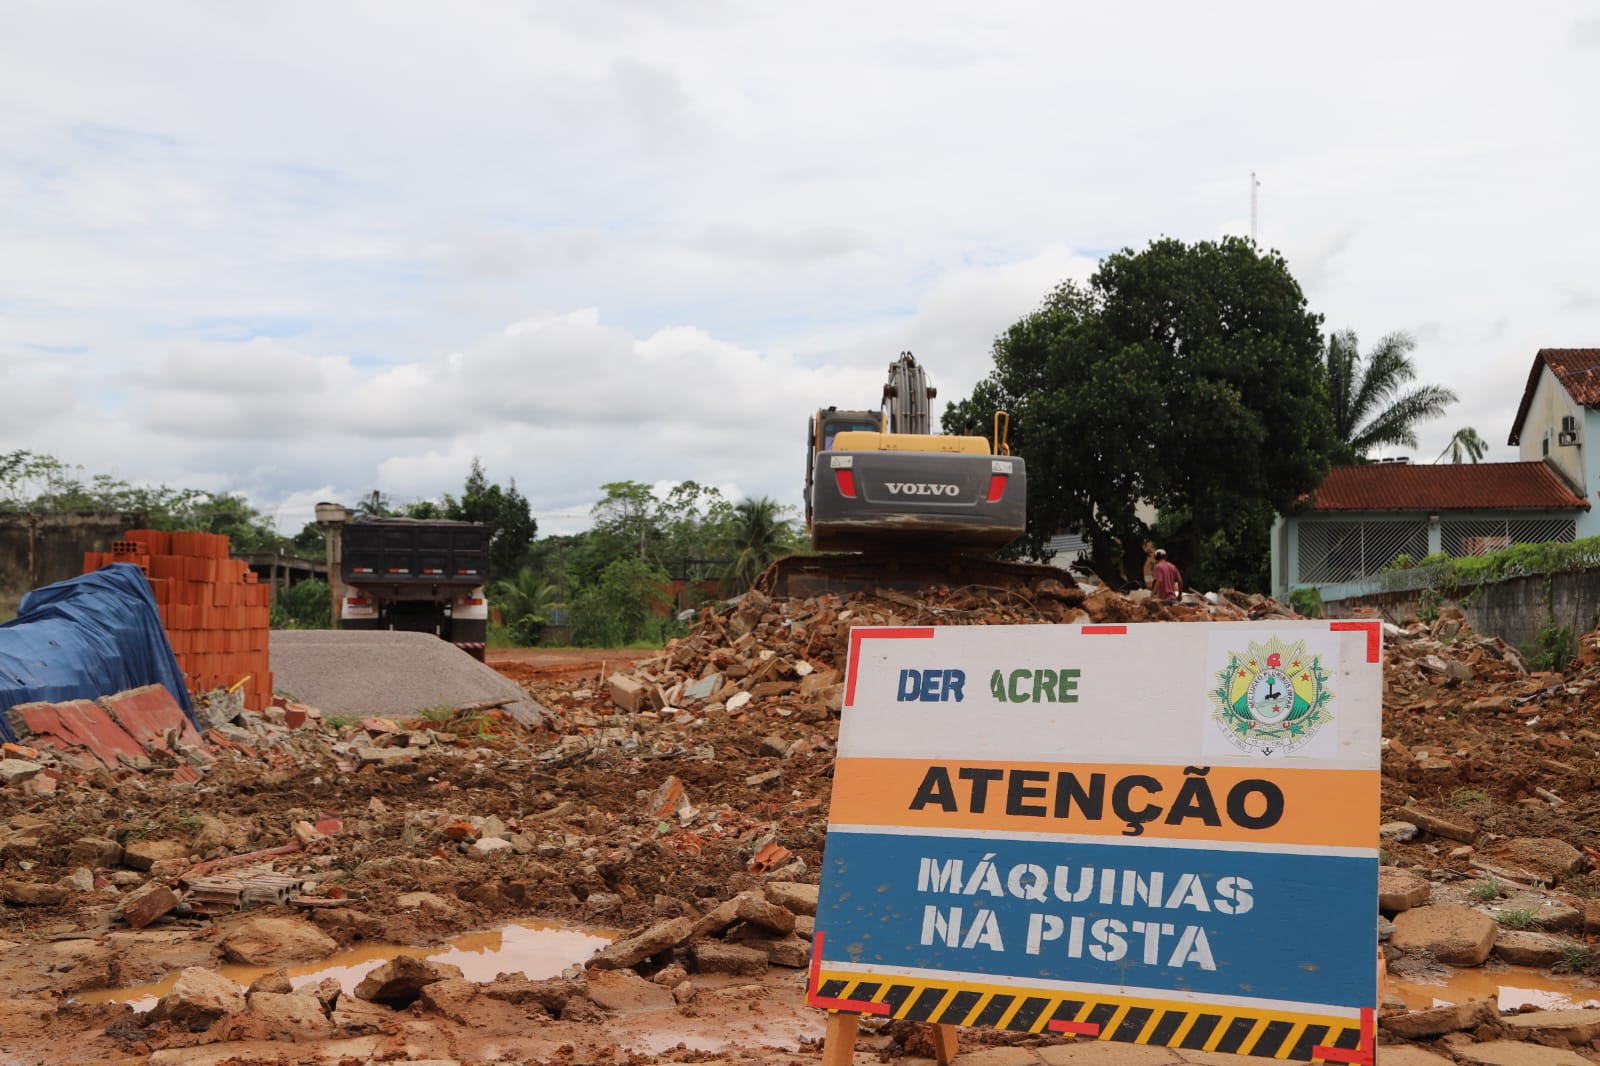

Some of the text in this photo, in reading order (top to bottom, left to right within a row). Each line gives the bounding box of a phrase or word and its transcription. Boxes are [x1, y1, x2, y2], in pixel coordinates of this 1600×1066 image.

[884, 482, 960, 496] VOLVO
[896, 668, 1082, 704] DER ACRE
[908, 765, 1285, 837] ATENÇÃO
[916, 852, 1255, 915] MÁQUINAS
[920, 904, 1218, 971] NA PISTA
